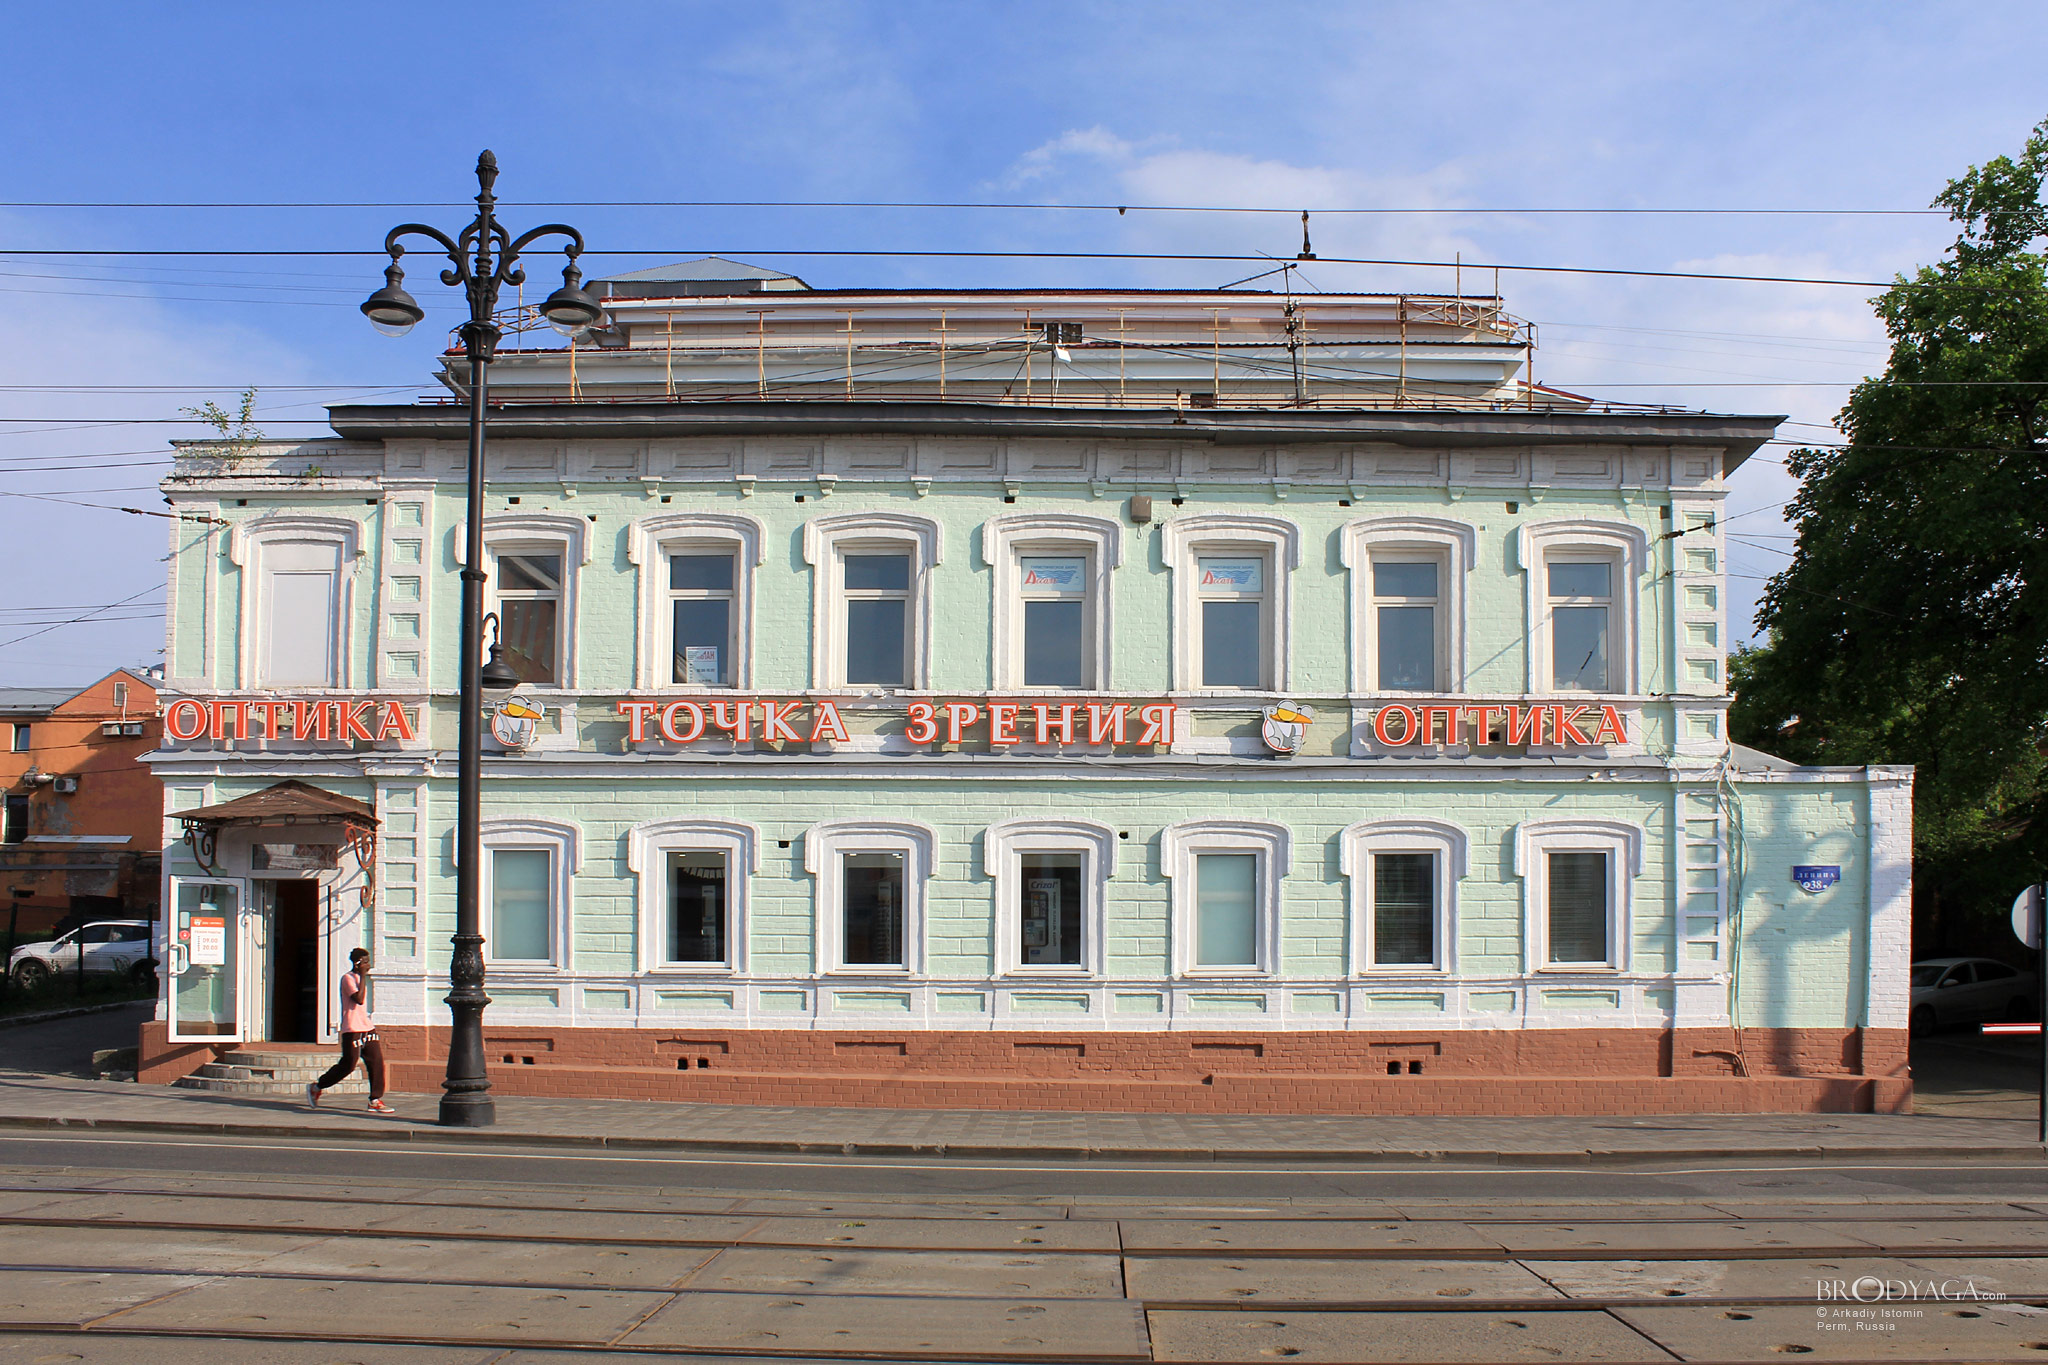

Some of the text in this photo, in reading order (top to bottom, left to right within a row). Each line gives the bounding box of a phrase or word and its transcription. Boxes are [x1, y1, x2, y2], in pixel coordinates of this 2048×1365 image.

[165, 698, 415, 742] ОПТИКА
[616, 700, 1177, 746] ТОЧКА ЗРЕНИЯ
[1373, 703, 1630, 747] ОПТИКА
[1031, 881, 1056, 889] Crizal
